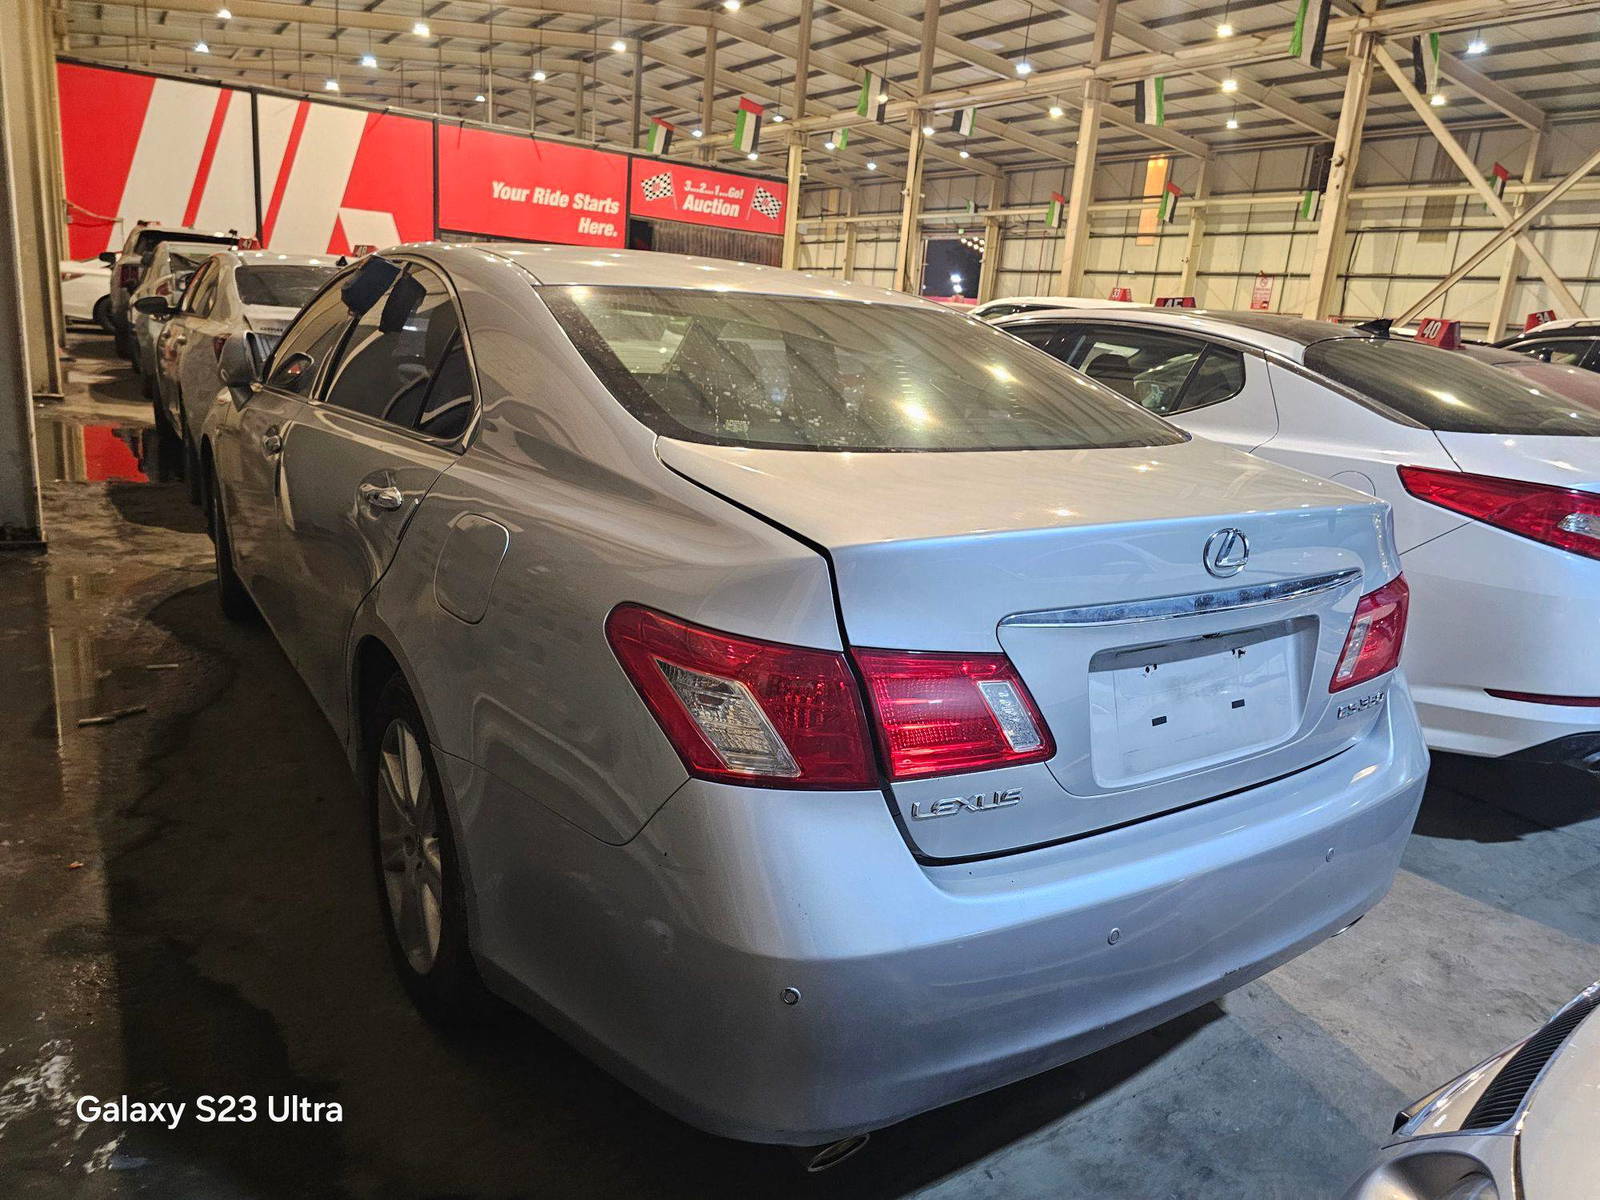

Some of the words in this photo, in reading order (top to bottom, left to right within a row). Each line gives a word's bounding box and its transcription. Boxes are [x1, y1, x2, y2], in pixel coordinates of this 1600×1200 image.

[491, 181, 530, 202] Your
[532, 186, 570, 208] Ride
[572, 193, 620, 214] Starts
[682, 194, 740, 217] Auction
[577, 217, 618, 237] Here.
[1422, 320, 1442, 339] 40
[911, 787, 1024, 820] LEXUS
